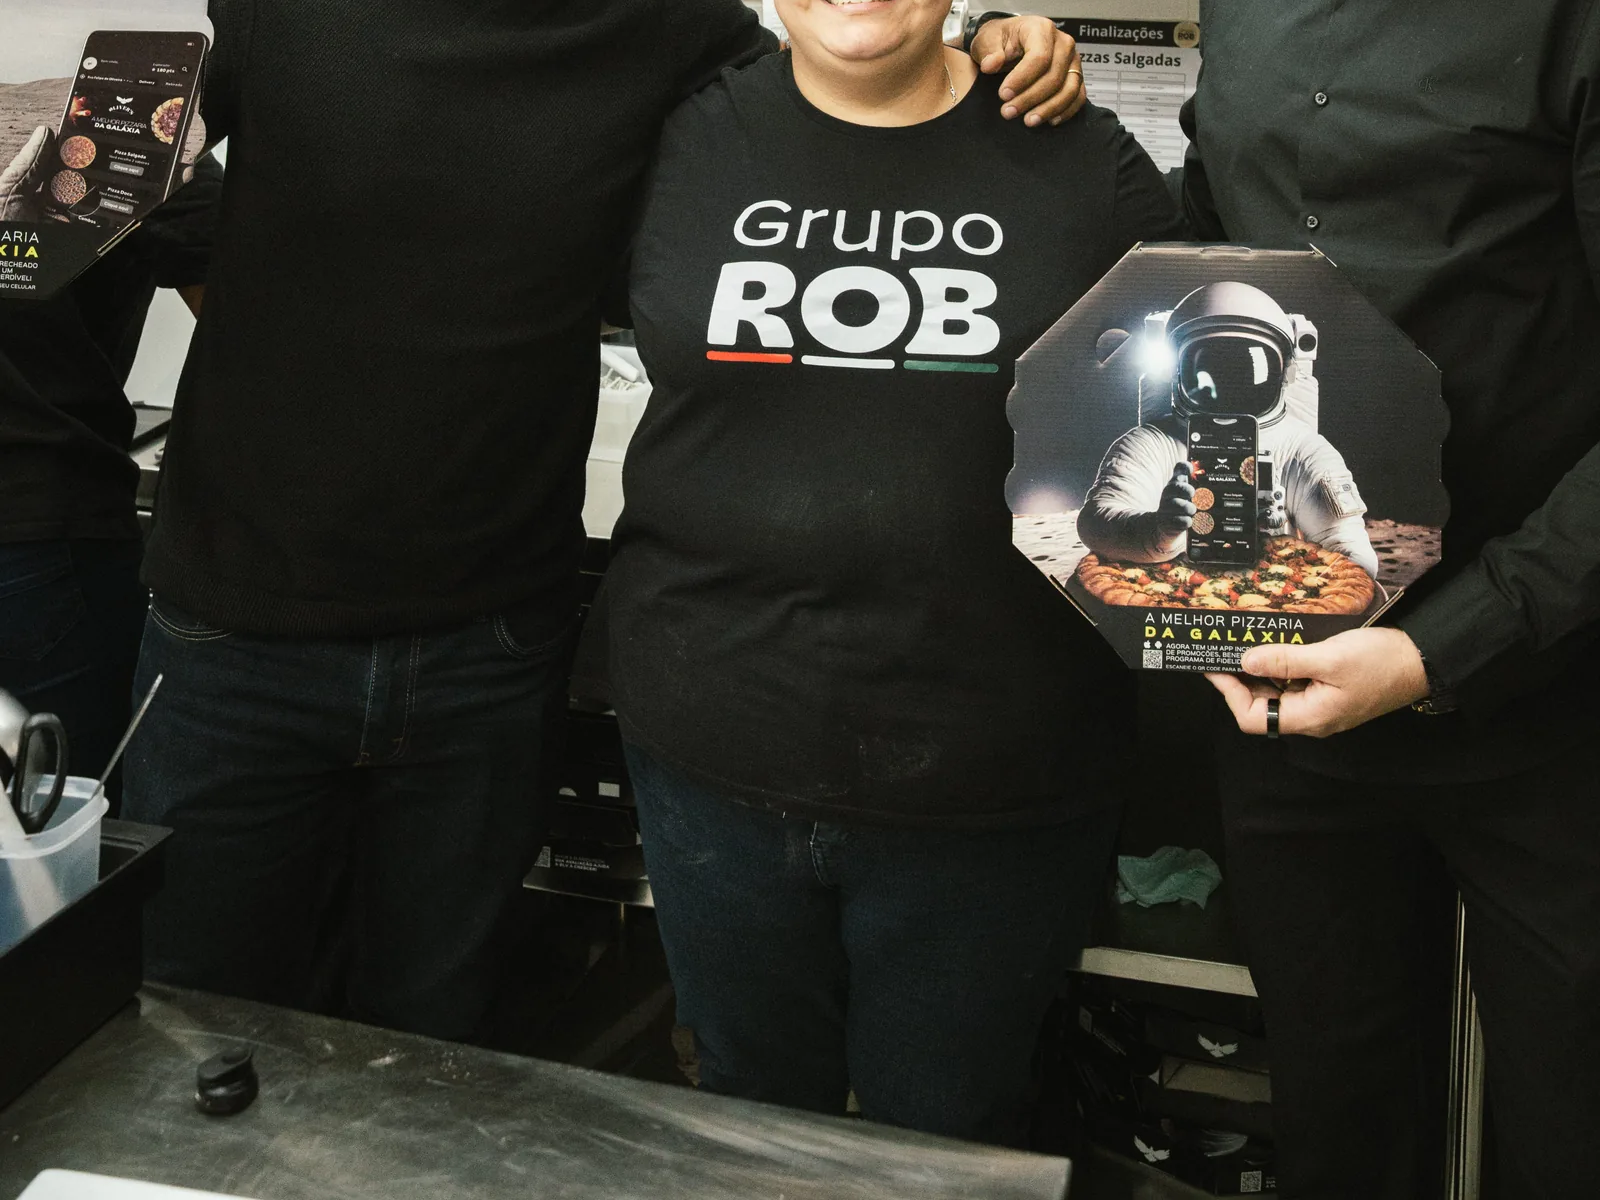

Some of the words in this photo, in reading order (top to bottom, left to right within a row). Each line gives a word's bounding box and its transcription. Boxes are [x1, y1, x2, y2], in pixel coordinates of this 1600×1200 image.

[1079, 25, 1164, 42] Finalizações
[1079, 53, 1110, 63] zzas
[1114, 52, 1181, 68] Salgadas
[96, 117, 120, 125] MELHOR
[121, 120, 147, 129] PIZZARIA
[106, 123, 140, 134] GALÁXIA
[733, 200, 1003, 260] Grupo
[707, 261, 1000, 356] ROB
[1145, 612, 1155, 623] A
[1162, 613, 1225, 626] MELHOR
[1232, 616, 1304, 630] PIZZARIA
[1145, 626, 1175, 639] DA
[1190, 627, 1304, 644] GALÁXIA
